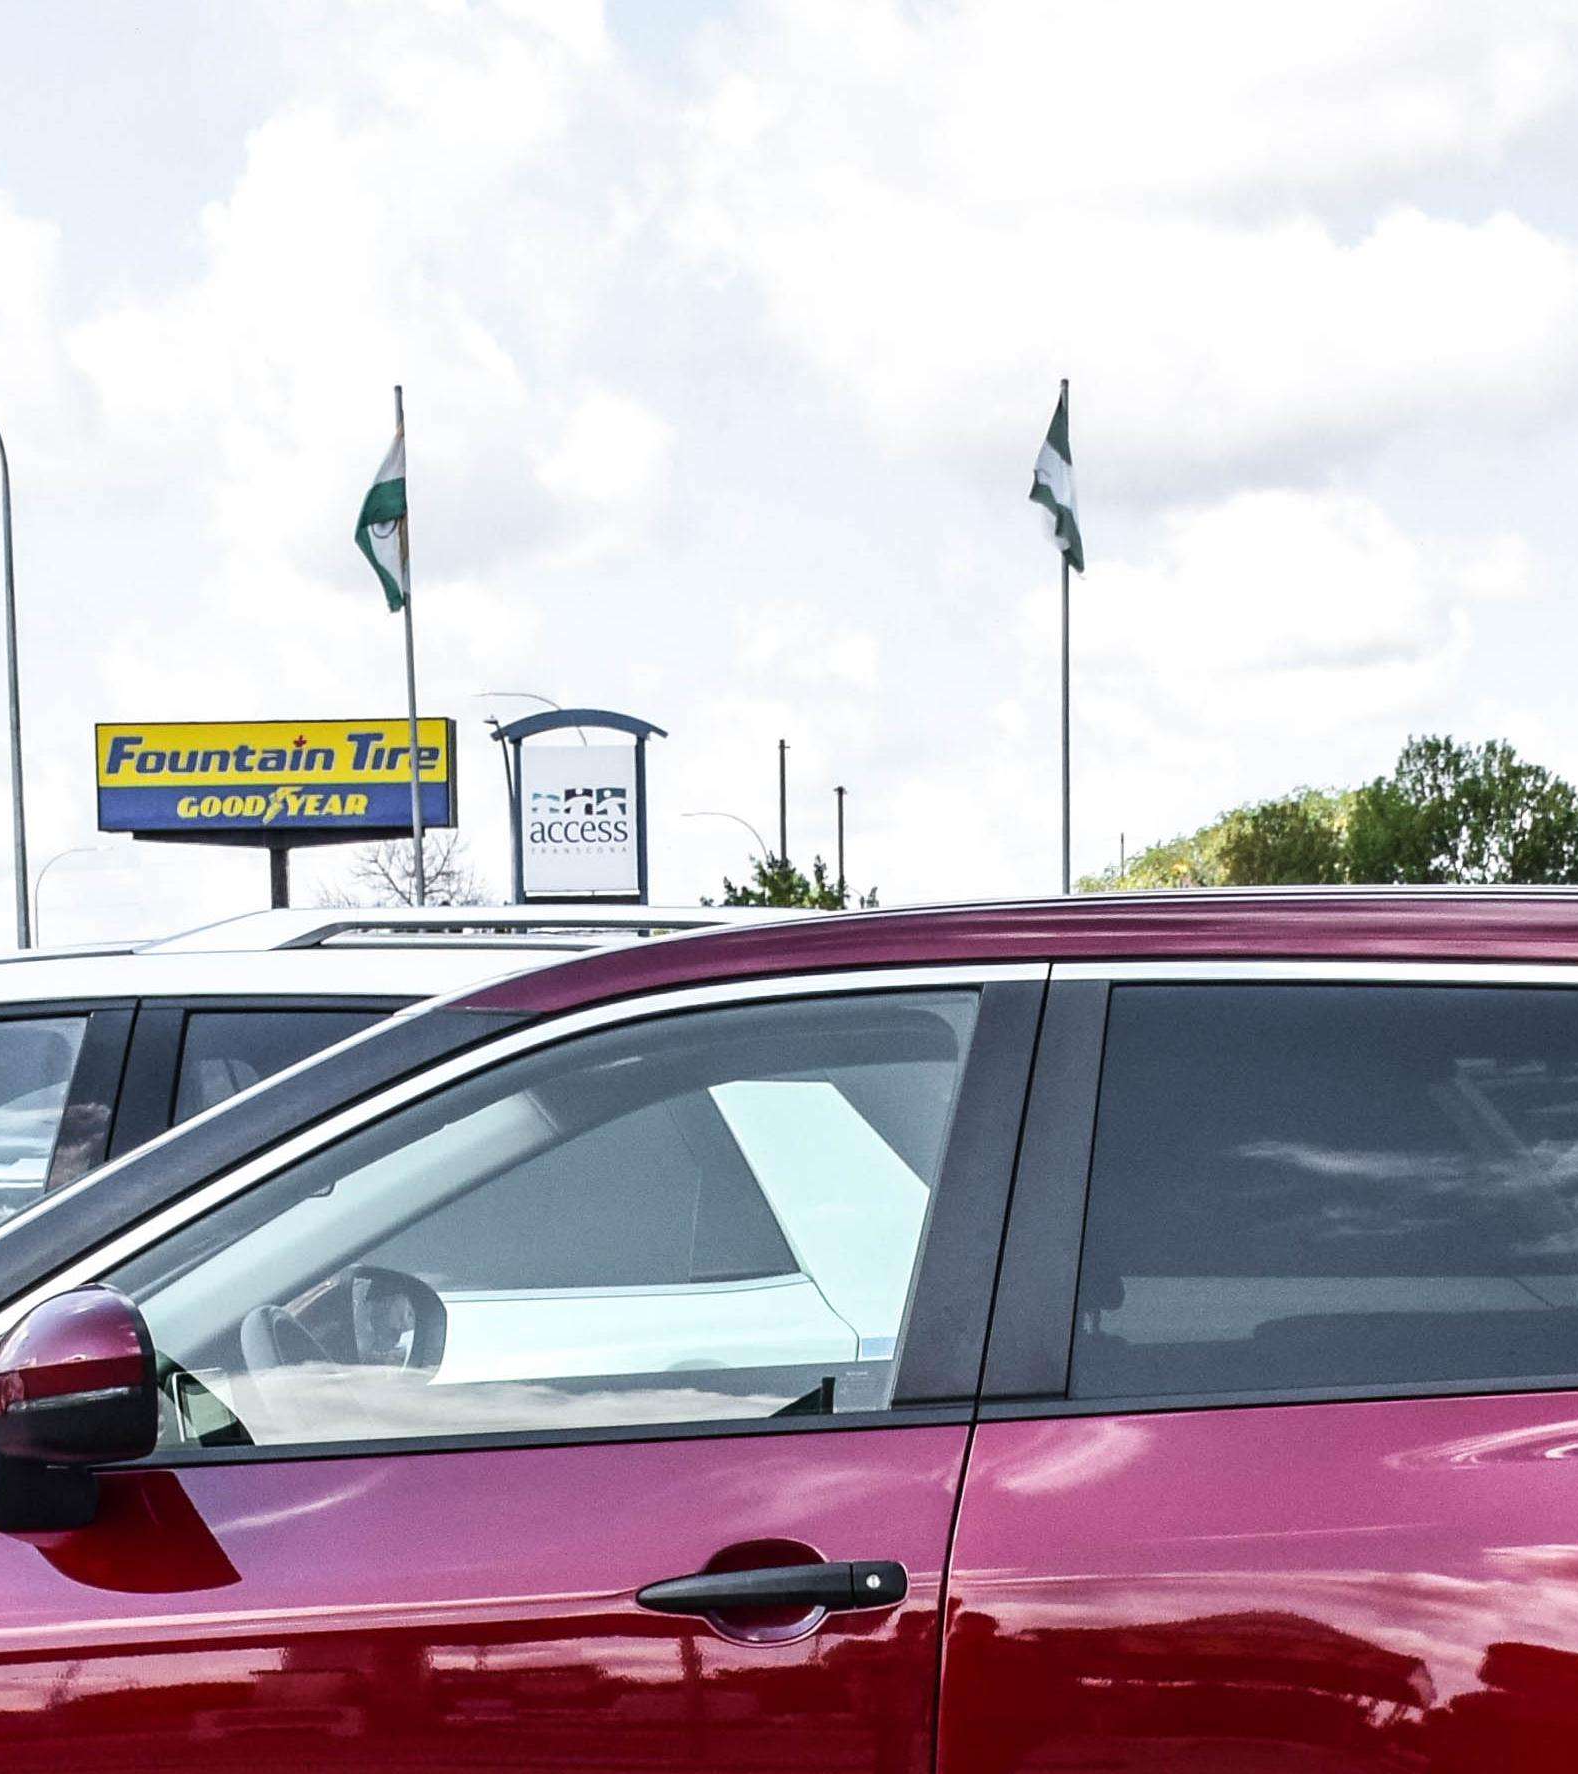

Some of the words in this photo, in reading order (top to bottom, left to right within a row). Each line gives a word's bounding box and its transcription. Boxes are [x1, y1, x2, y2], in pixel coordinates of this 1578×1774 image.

[105, 735, 335, 775] Fountain
[347, 732, 439, 772] Tire
[177, 788, 369, 821] GOODYEAR
[530, 820, 628, 843] access
